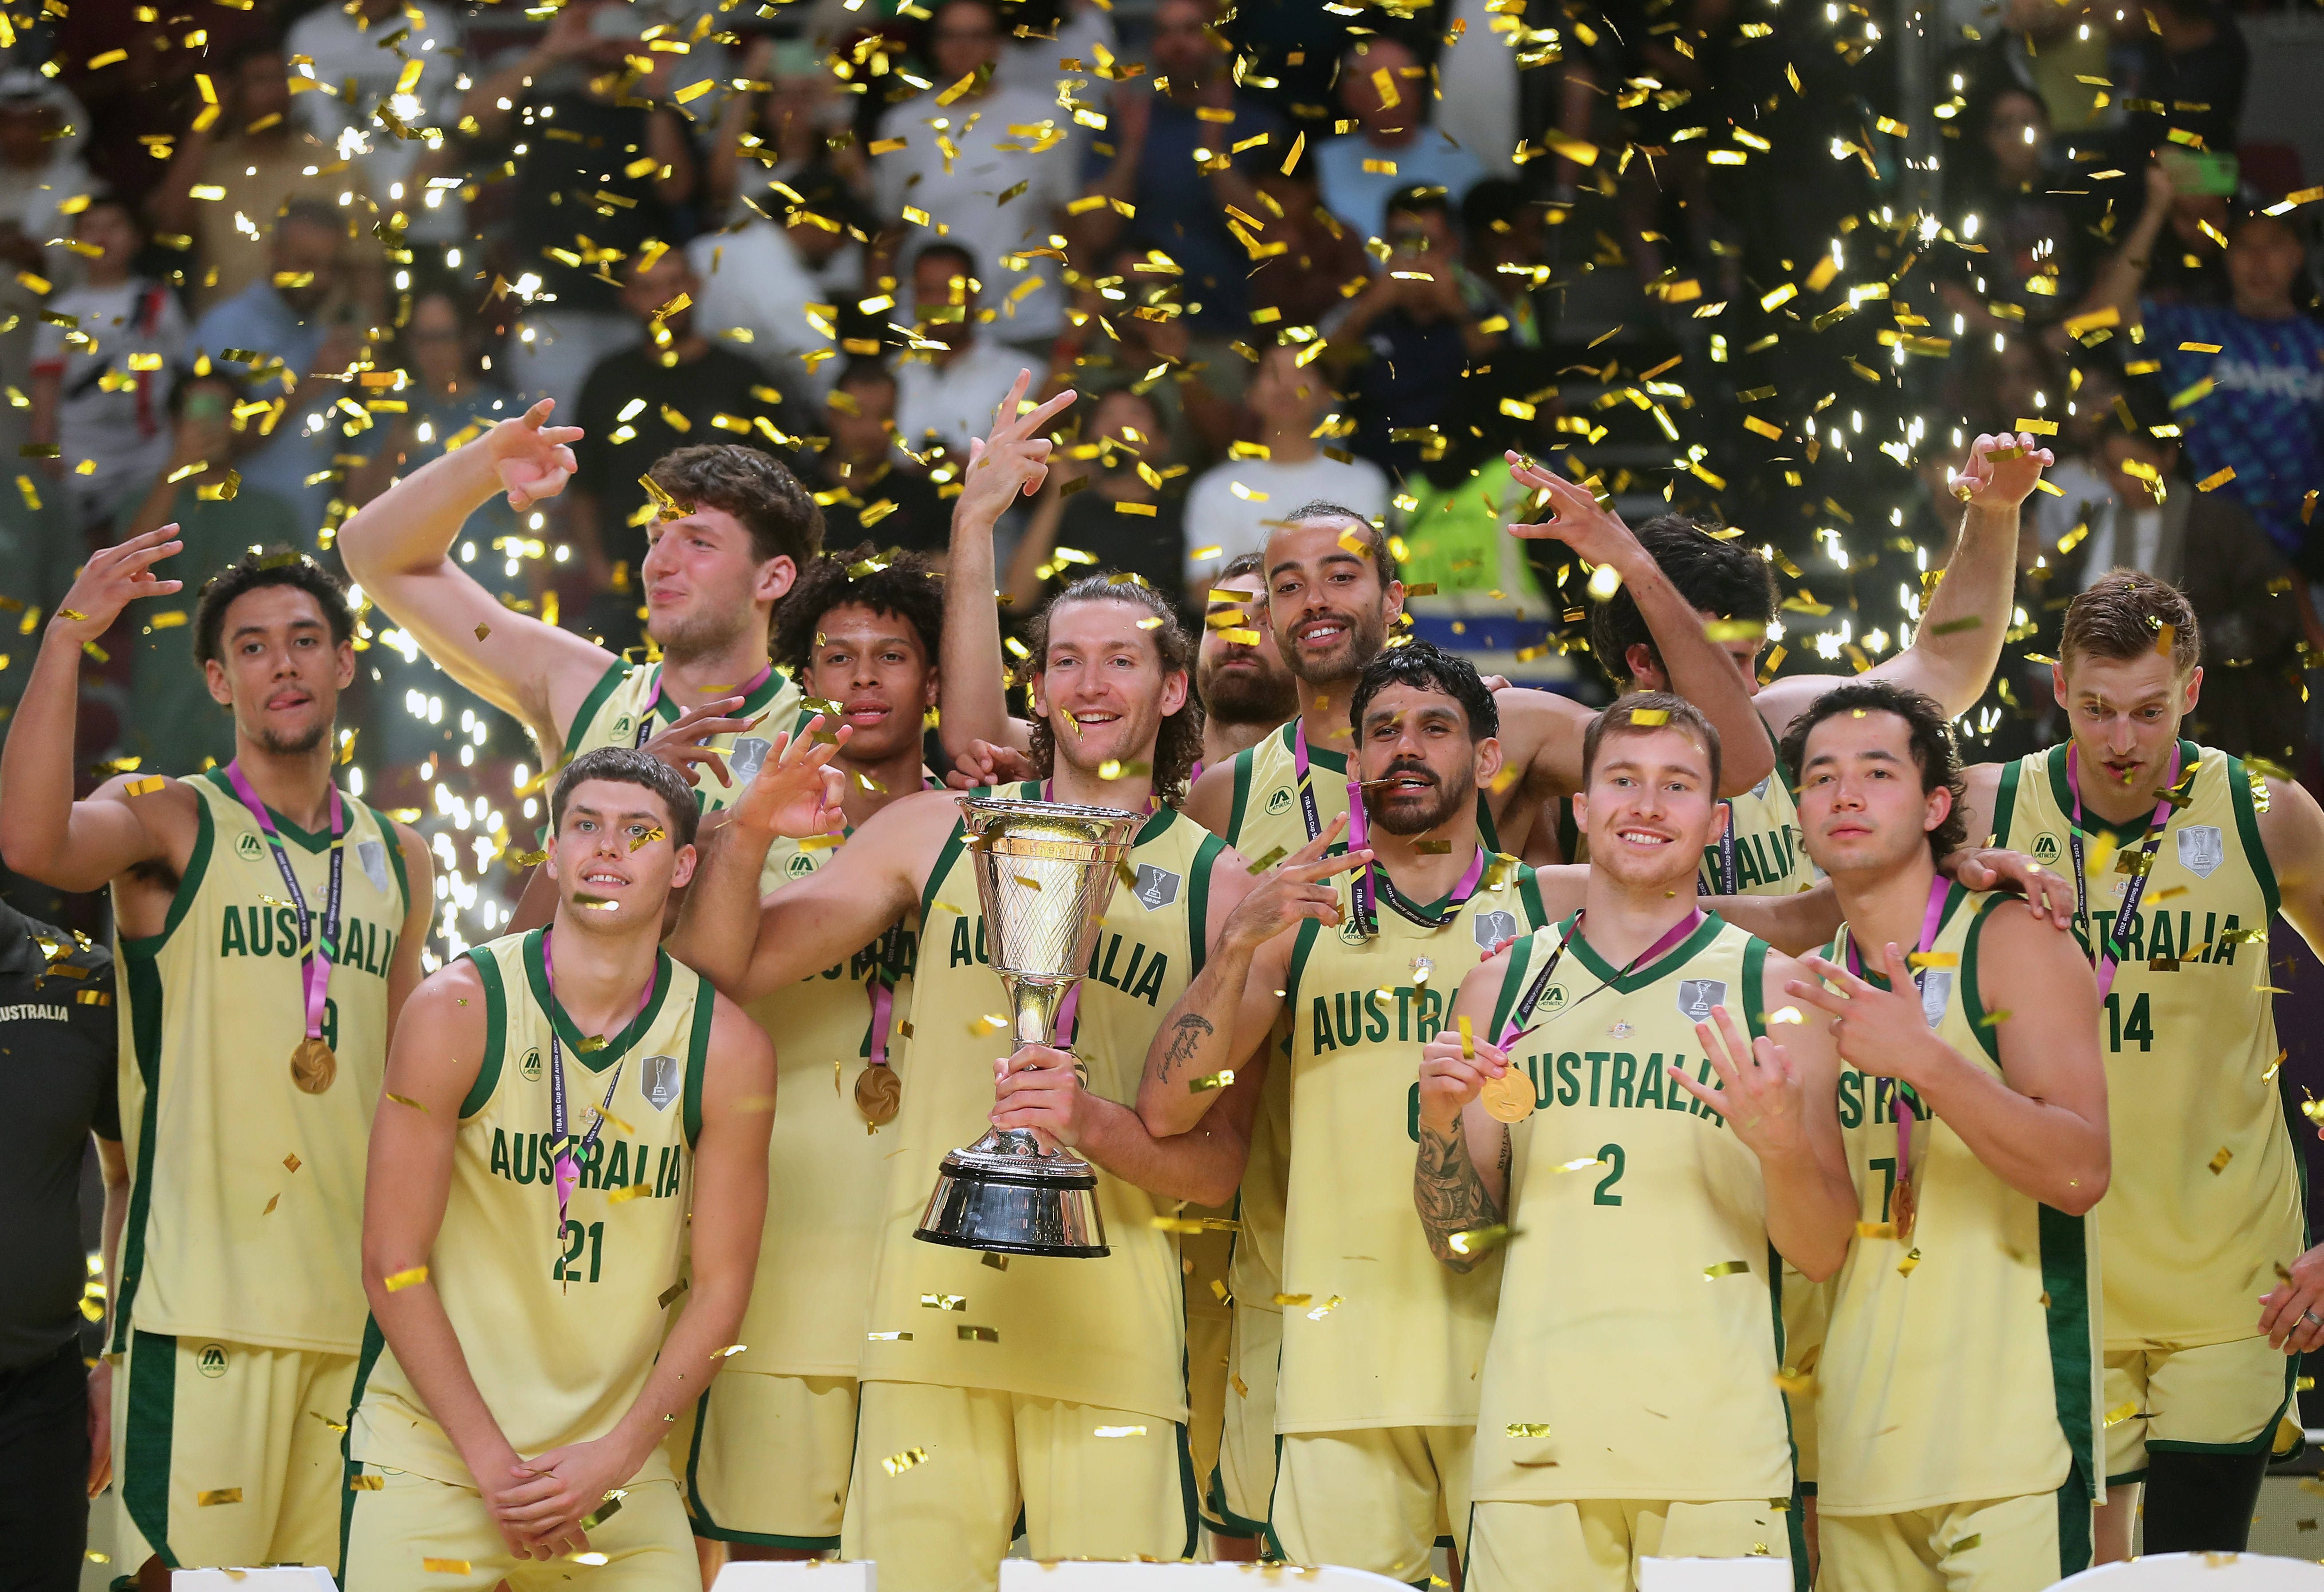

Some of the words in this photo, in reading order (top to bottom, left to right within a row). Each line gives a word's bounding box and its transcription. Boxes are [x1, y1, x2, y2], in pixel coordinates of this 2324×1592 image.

[2134, 876, 2142, 887] Cup
[1386, 884, 1394, 898] 2025
[2130, 887, 2139, 903] Saudi
[1391, 899, 1406, 912] Arabia
[2123, 903, 2133, 922] Arabia
[1406, 911, 1420, 921] Saudi
[2118, 922, 2127, 936] 2025
[0, 1004, 68, 1022] USTRALIA
[2104, 993, 2153, 1053] 14
[587, 1130, 596, 1143] 2025
[1594, 1144, 1625, 1206] 2
[1870, 1158, 1895, 1223] 7
[553, 1220, 604, 1282] 21
